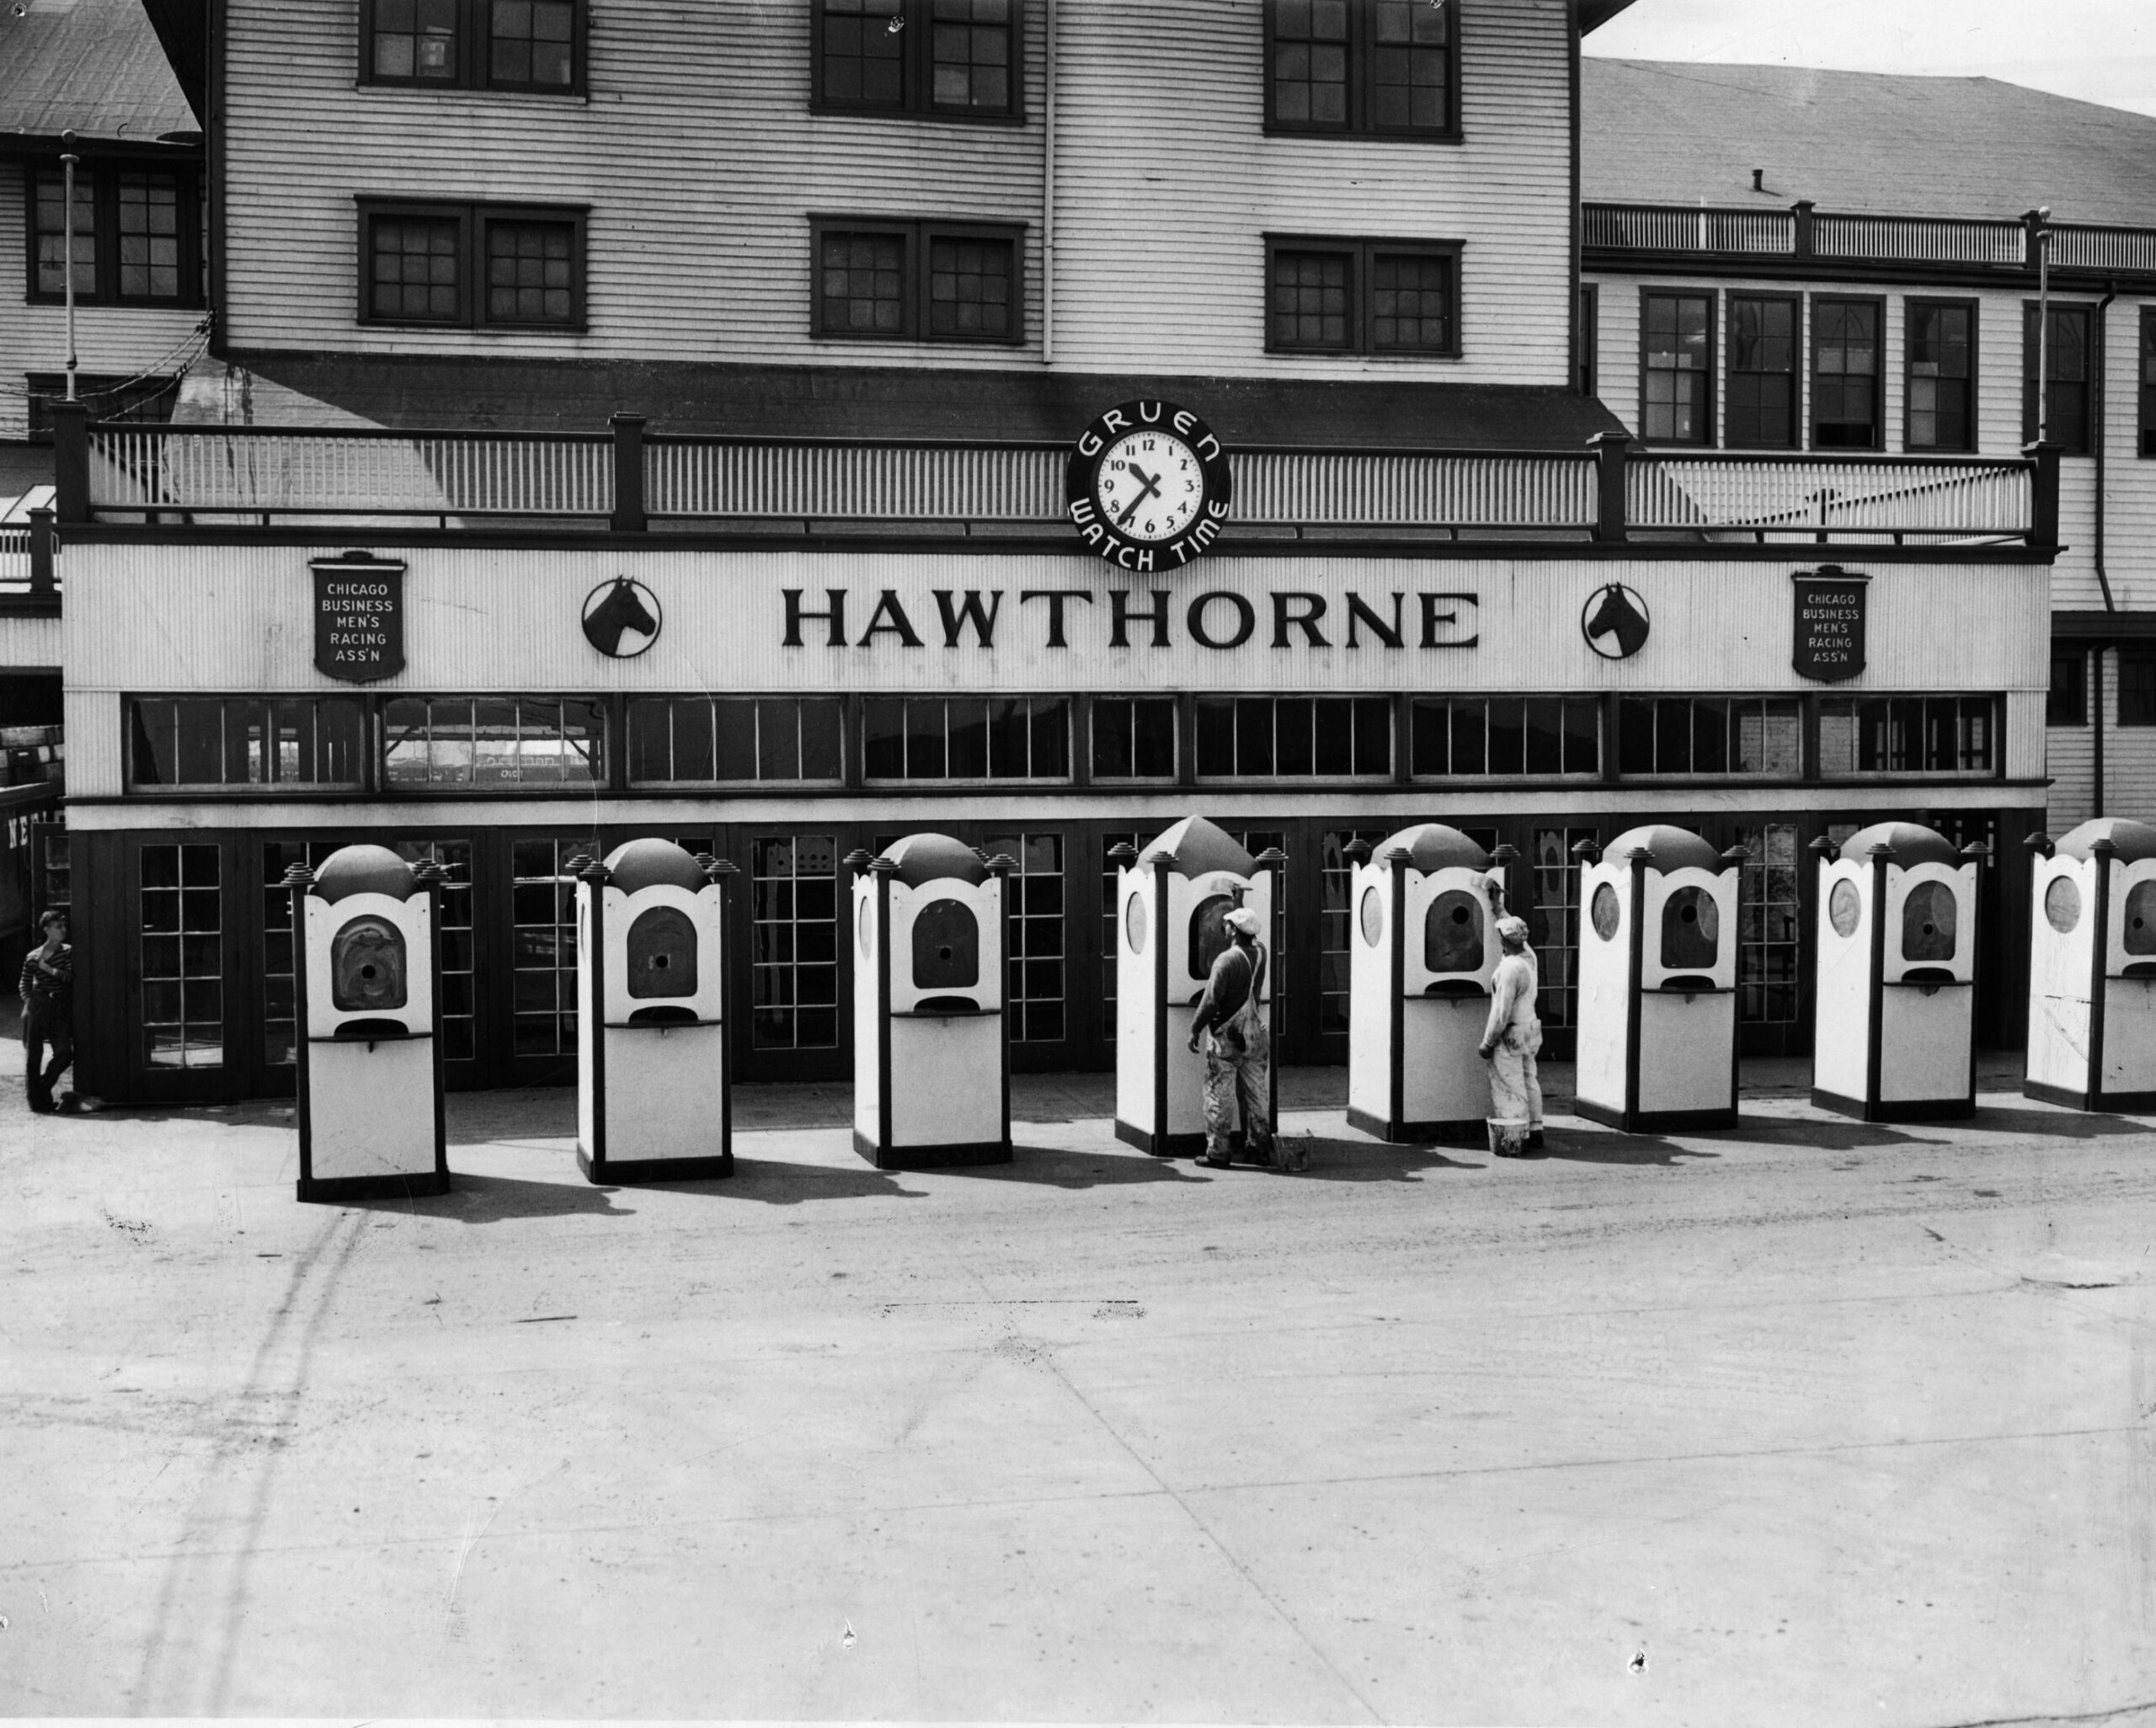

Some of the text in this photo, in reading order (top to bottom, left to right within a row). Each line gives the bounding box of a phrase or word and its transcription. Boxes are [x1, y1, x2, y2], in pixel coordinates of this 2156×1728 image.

[1126, 445, 1135, 456] 11
[1143, 440, 1155, 451] 12
[1168, 445, 1172, 456] 1
[1111, 460, 1125, 471] 10
[1180, 459, 1187, 471] 2
[1105, 480, 1114, 493] 9
[1185, 480, 1194, 493] 3
[1110, 499, 1120, 513] 8
[1177, 500, 1187, 515] 4
[1127, 516, 1135, 528] 7
[1145, 519, 1155, 533] 6
[1166, 516, 1175, 529] 5
[1070, 498, 1229, 571] WATCH TIME
[327, 583, 388, 595] CHICAGO
[322, 600, 393, 611] BUSINESS
[1807, 594, 1856, 605] CHICAGO
[781, 589, 1480, 650] HAWTHORNE
[1802, 609, 1859, 620] BUSINESS
[337, 614, 380, 628] MEN'S
[1813, 621, 1849, 633] MEN'S
[330, 633, 387, 644] RACING
[1808, 637, 1852, 648] RACING
[335, 648, 380, 661] ASS'N
[1812, 651, 1848, 663] ASS'N
